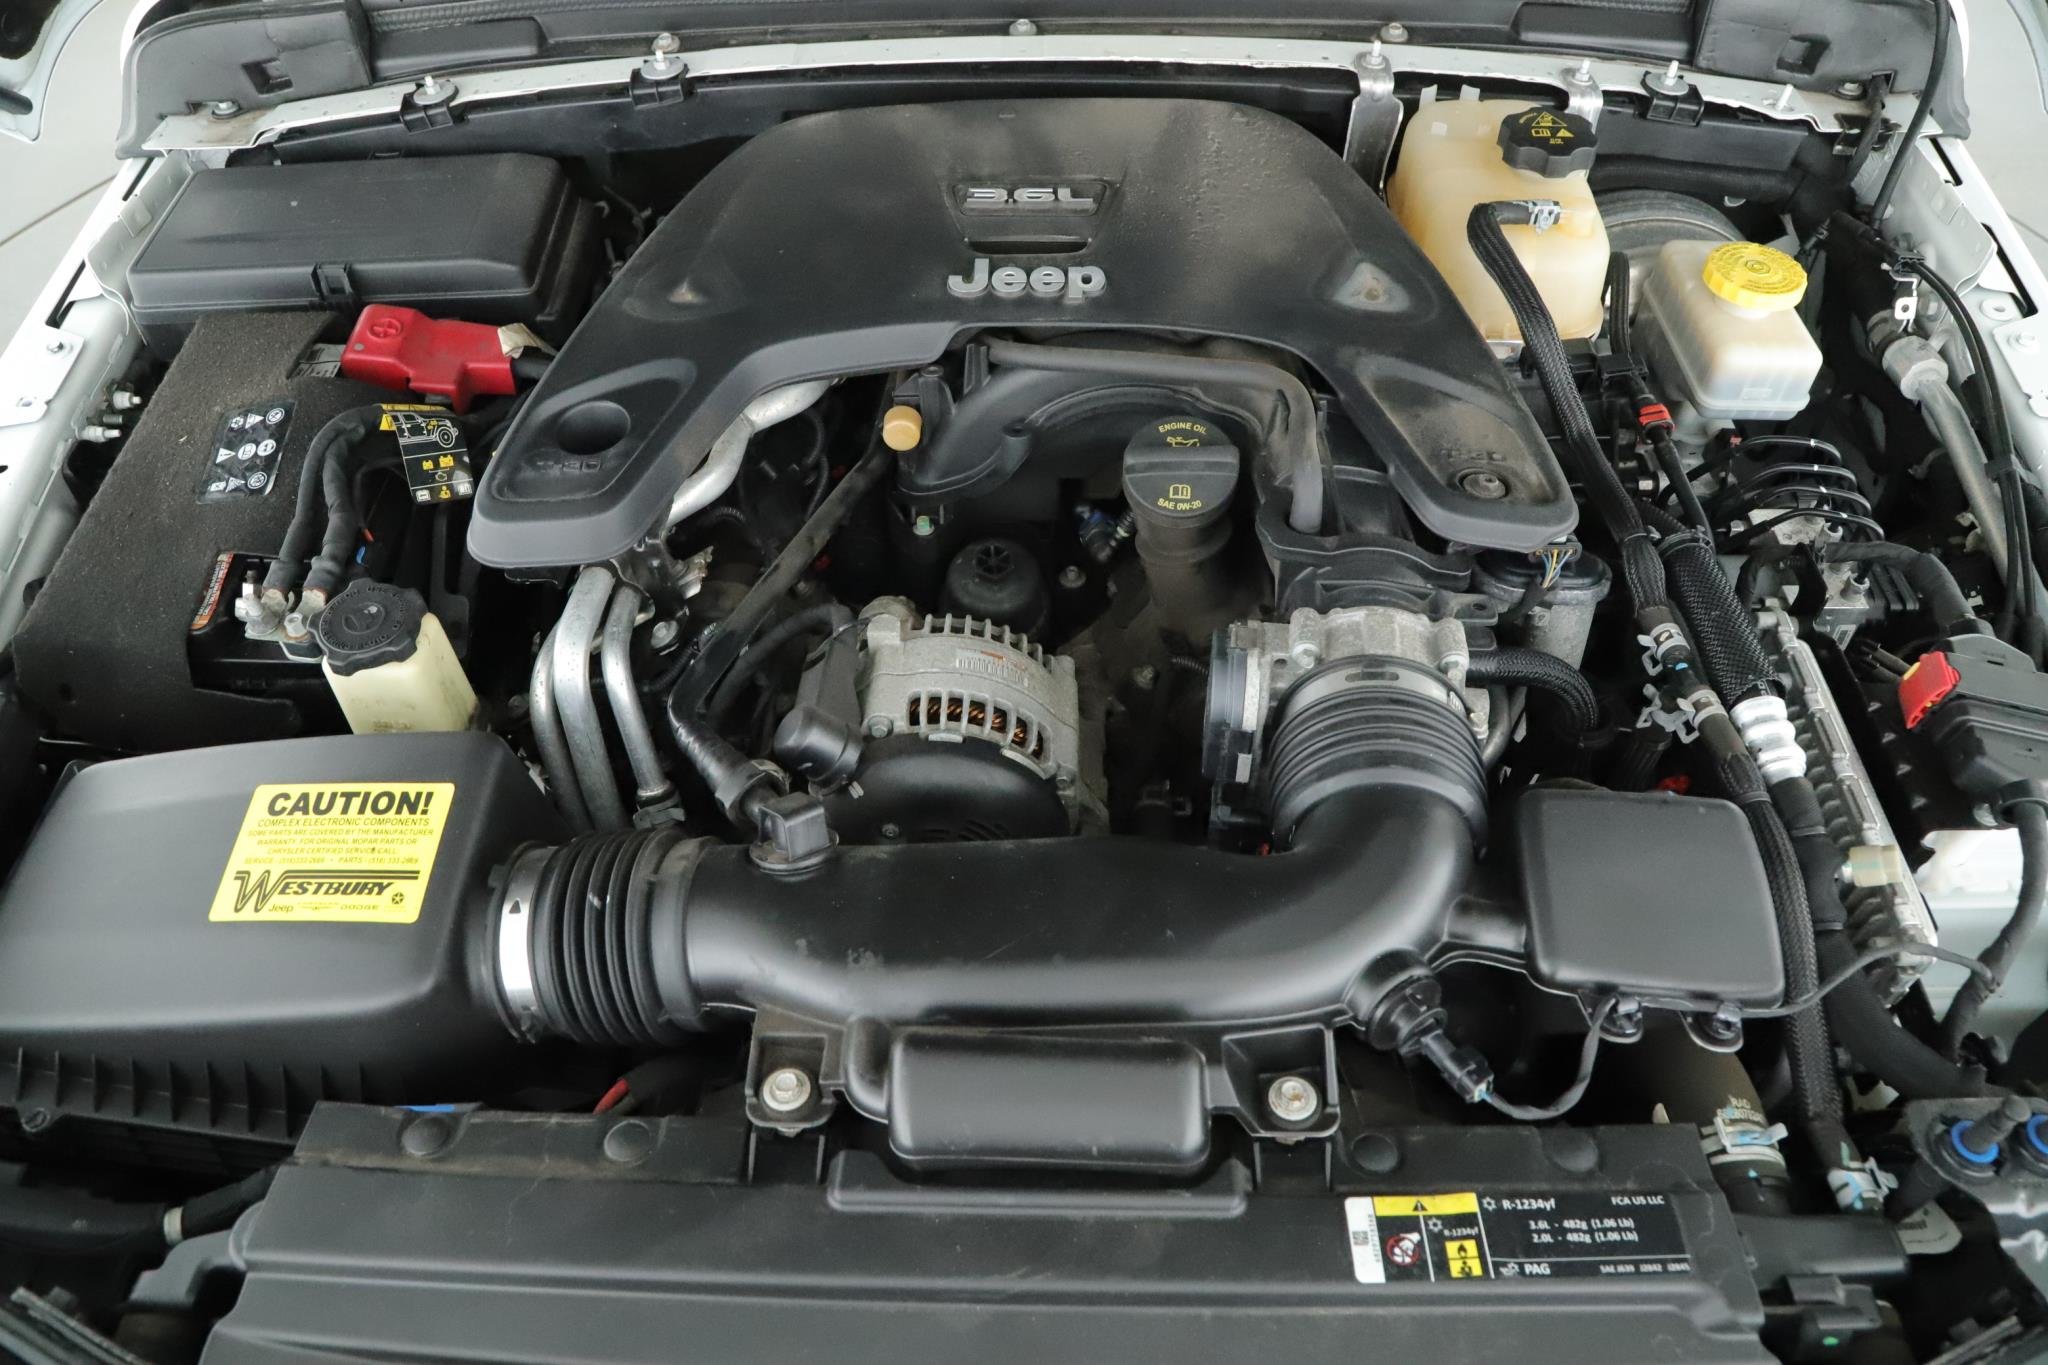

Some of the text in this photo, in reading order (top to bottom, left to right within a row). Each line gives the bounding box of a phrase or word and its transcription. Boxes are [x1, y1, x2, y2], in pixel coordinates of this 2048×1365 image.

[966, 187, 1094, 206] 3.6L
[947, 258, 1106, 302] Jeep
[1158, 421, 1207, 435] ENGINE OIL
[1157, 497, 1202, 511] SAE 0W-20
[267, 791, 434, 817] CAUTION!
[257, 817, 430, 827] COMPLEX ELECTRONIC COMPONENTS
[357, 829, 372, 837] THE
[373, 829, 434, 837] MANUFACTURER
[233, 869, 396, 913] WESTBURY
[268, 903, 294, 913] Jeep
[1502, 1197, 1556, 1211] R-1234yf
[1610, 1195, 1665, 1206] FCA US LLC
[1528, 1219, 1551, 1230] 3.6L
[1562, 1219, 1588, 1231] 482g
[1590, 1217, 1617, 1230] (1.06
[1443, 1226, 1479, 1237] R-1234yf
[1531, 1233, 1554, 1243] 2.0L
[1566, 1232, 1592, 1244] 482g
[1594, 1231, 1621, 1243] (1.06
[1524, 1262, 1551, 1275] PAG
